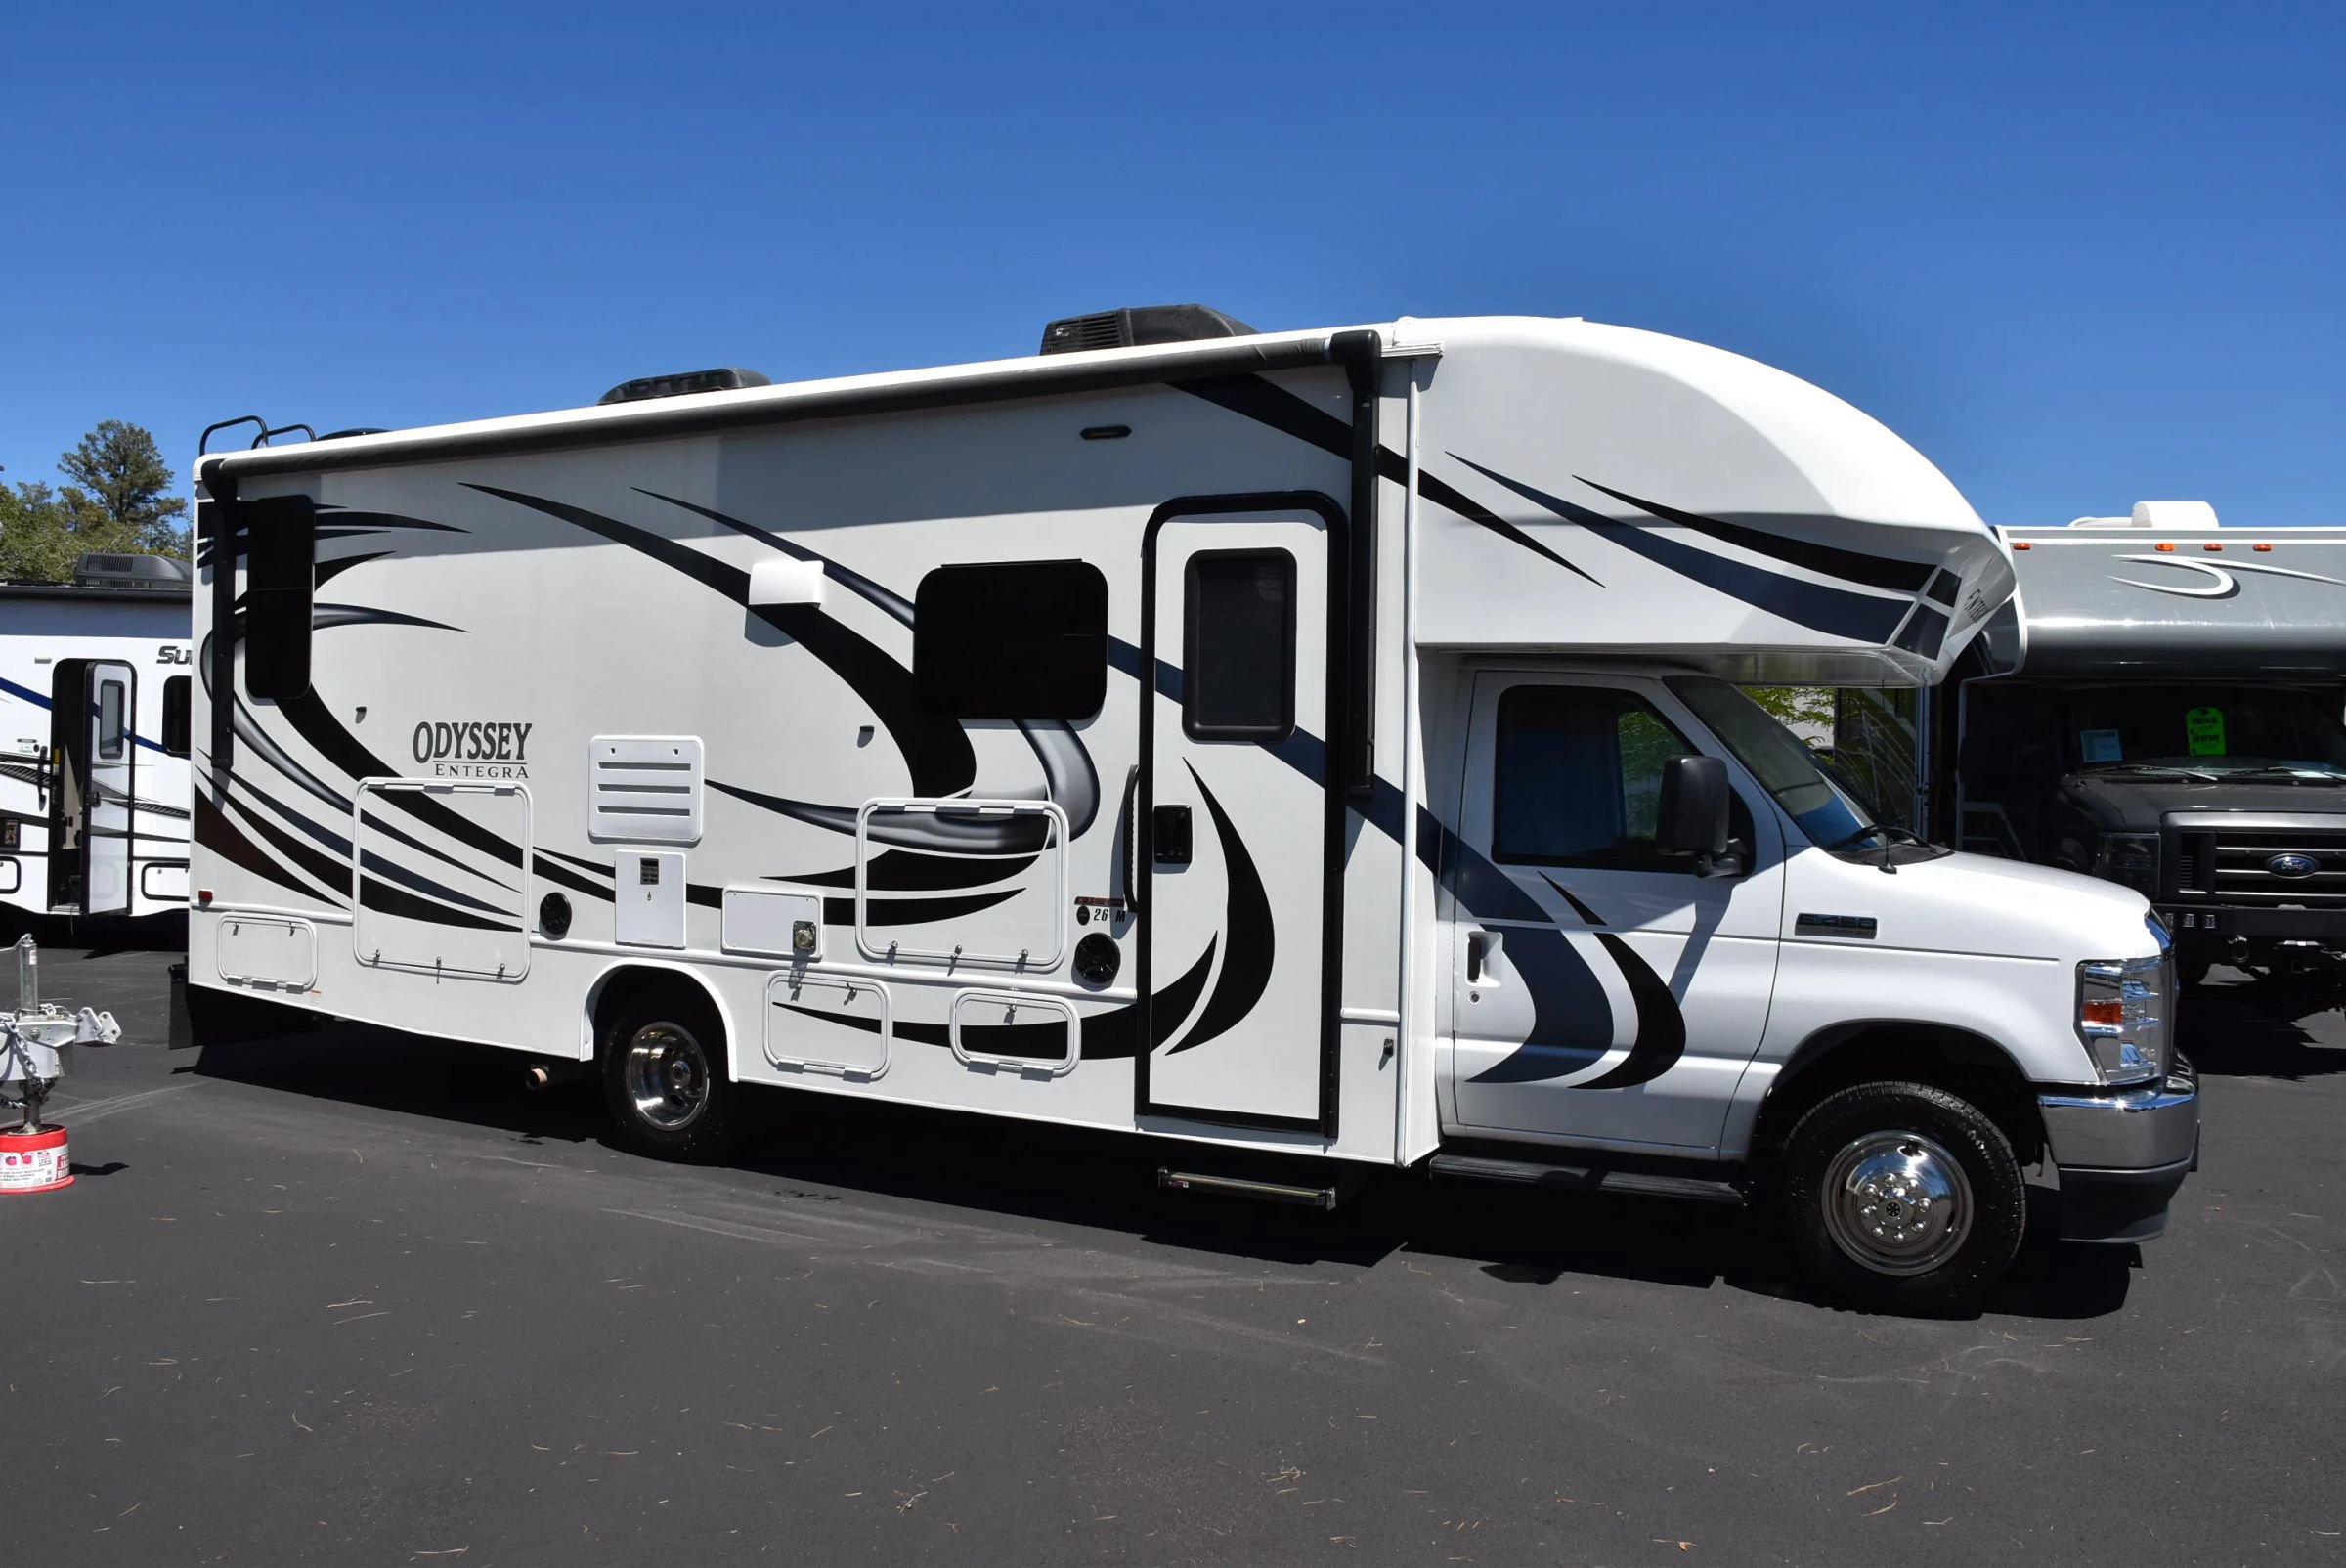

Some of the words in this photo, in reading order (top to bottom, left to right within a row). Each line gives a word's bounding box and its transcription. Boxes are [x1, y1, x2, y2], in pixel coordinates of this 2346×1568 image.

[156, 645, 193, 665] Su
[413, 721, 533, 763] ODYSSEY
[435, 763, 529, 779] ENTEGRA
[1093, 908, 1109, 922] 26
[1115, 910, 1126, 923] M
